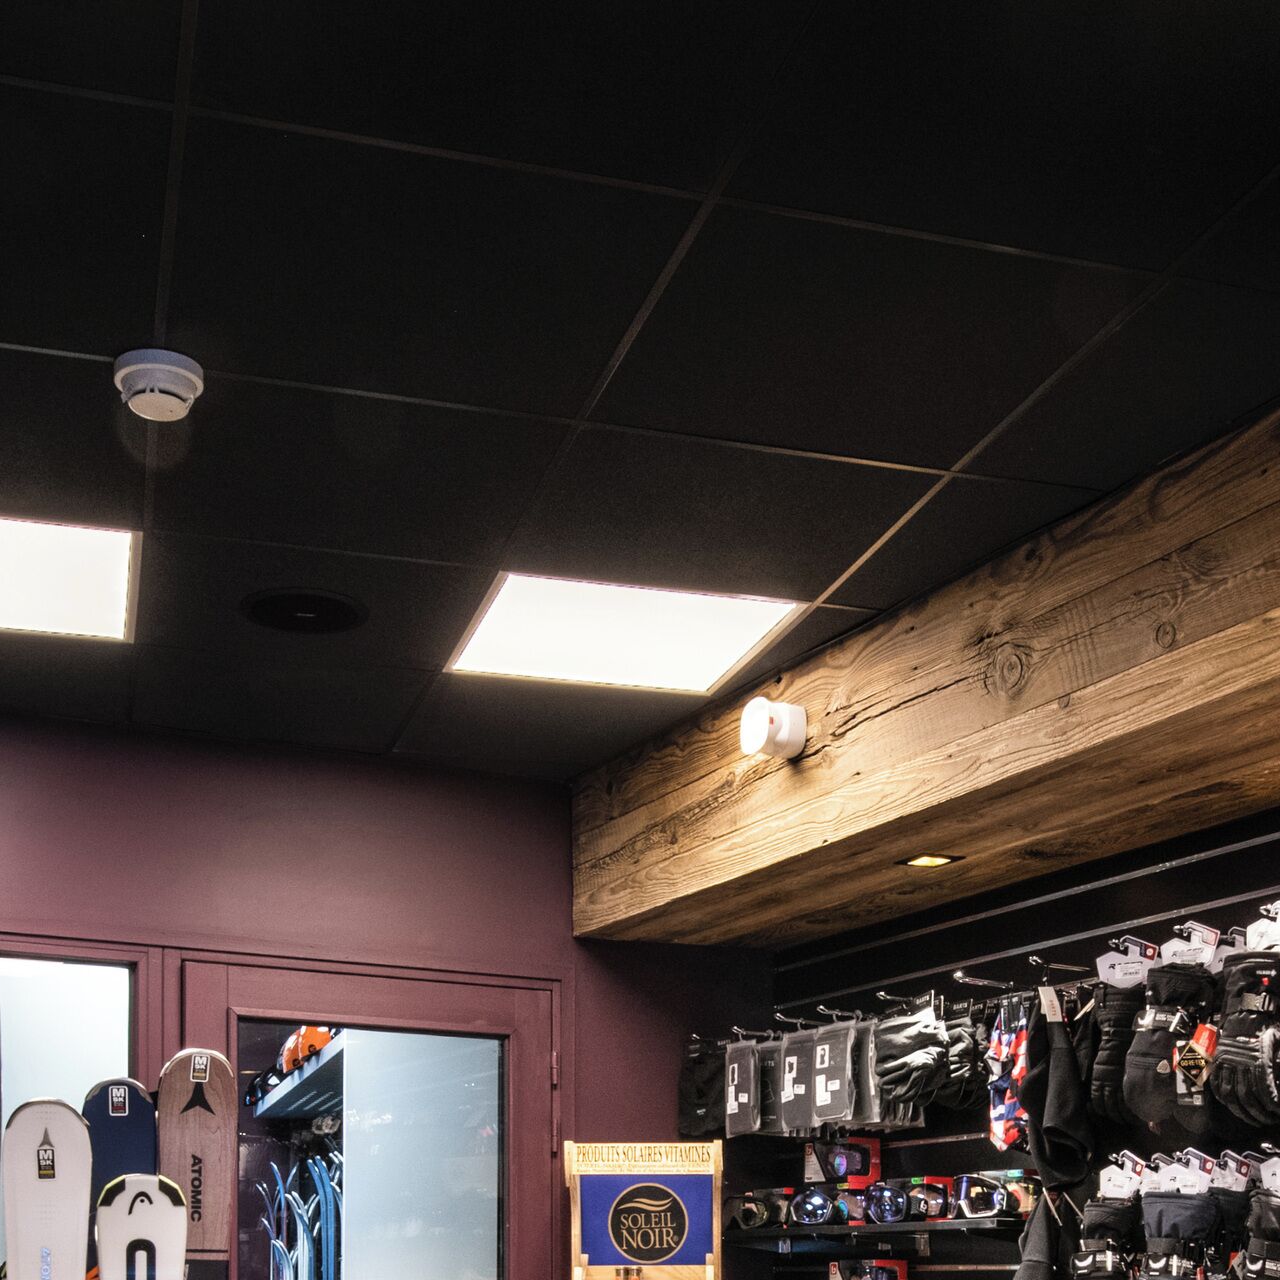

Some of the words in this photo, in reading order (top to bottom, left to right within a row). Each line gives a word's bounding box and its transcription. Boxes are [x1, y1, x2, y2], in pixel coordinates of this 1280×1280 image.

[577, 1145, 620, 1163] PRODUITS
[622, 1145, 663, 1163] SOLAIRES
[190, 1153, 204, 1224] ATOMIC
[620, 1212, 677, 1229] SOLEIL
